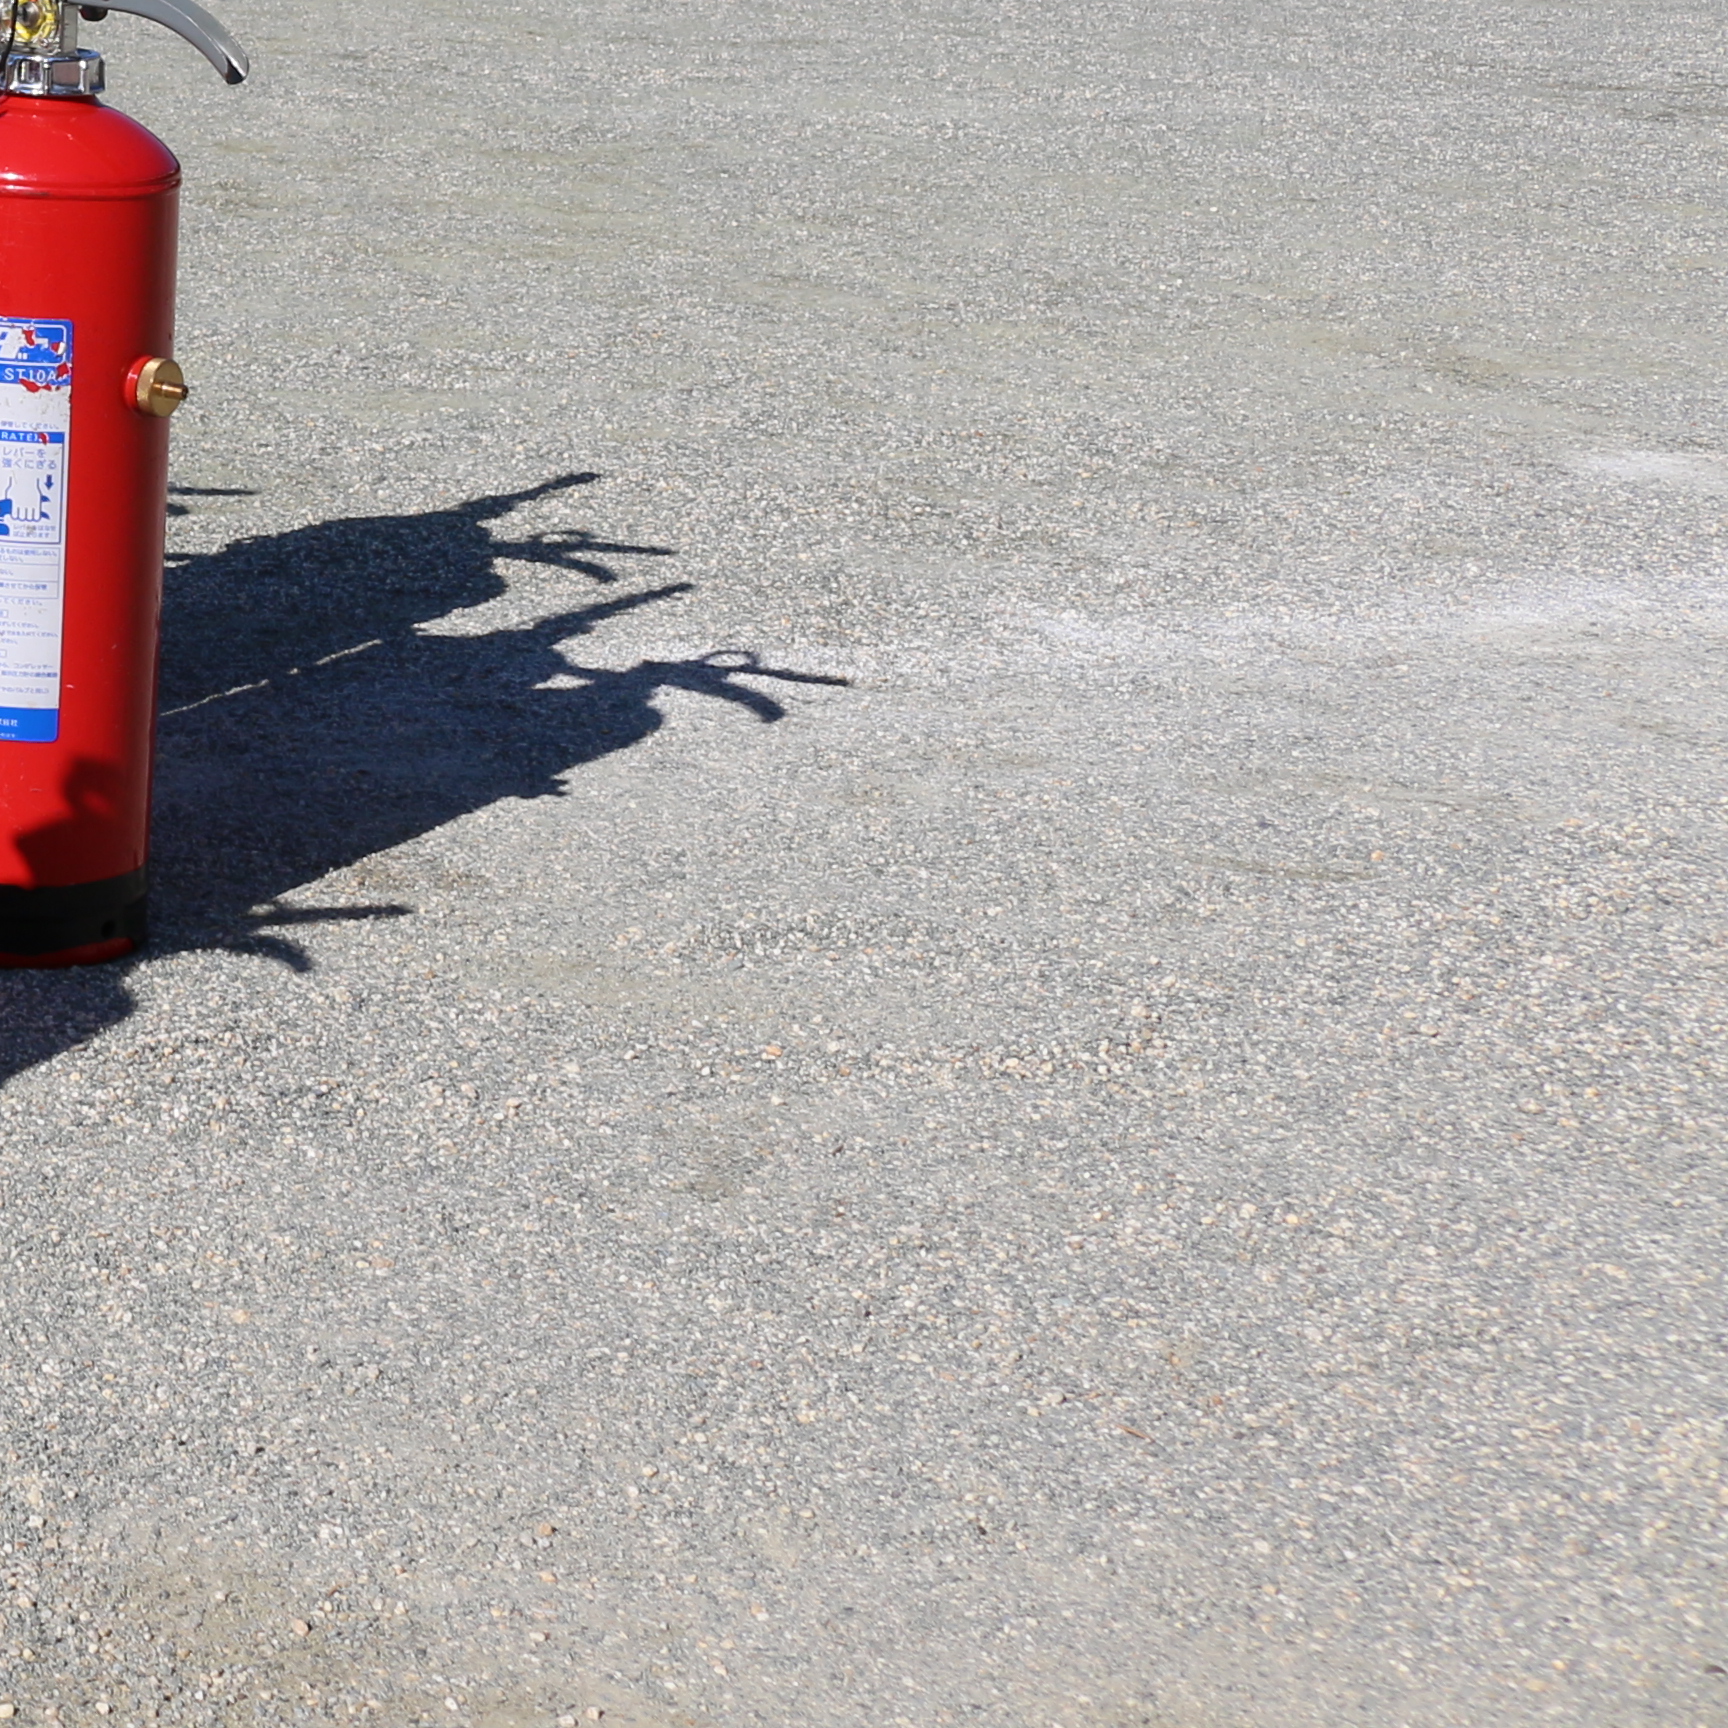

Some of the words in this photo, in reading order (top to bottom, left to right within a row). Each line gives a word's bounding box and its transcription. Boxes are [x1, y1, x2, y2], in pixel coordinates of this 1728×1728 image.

[3, 447, 46, 458] レバーを
[2, 459, 57, 470] 強くにぎる
